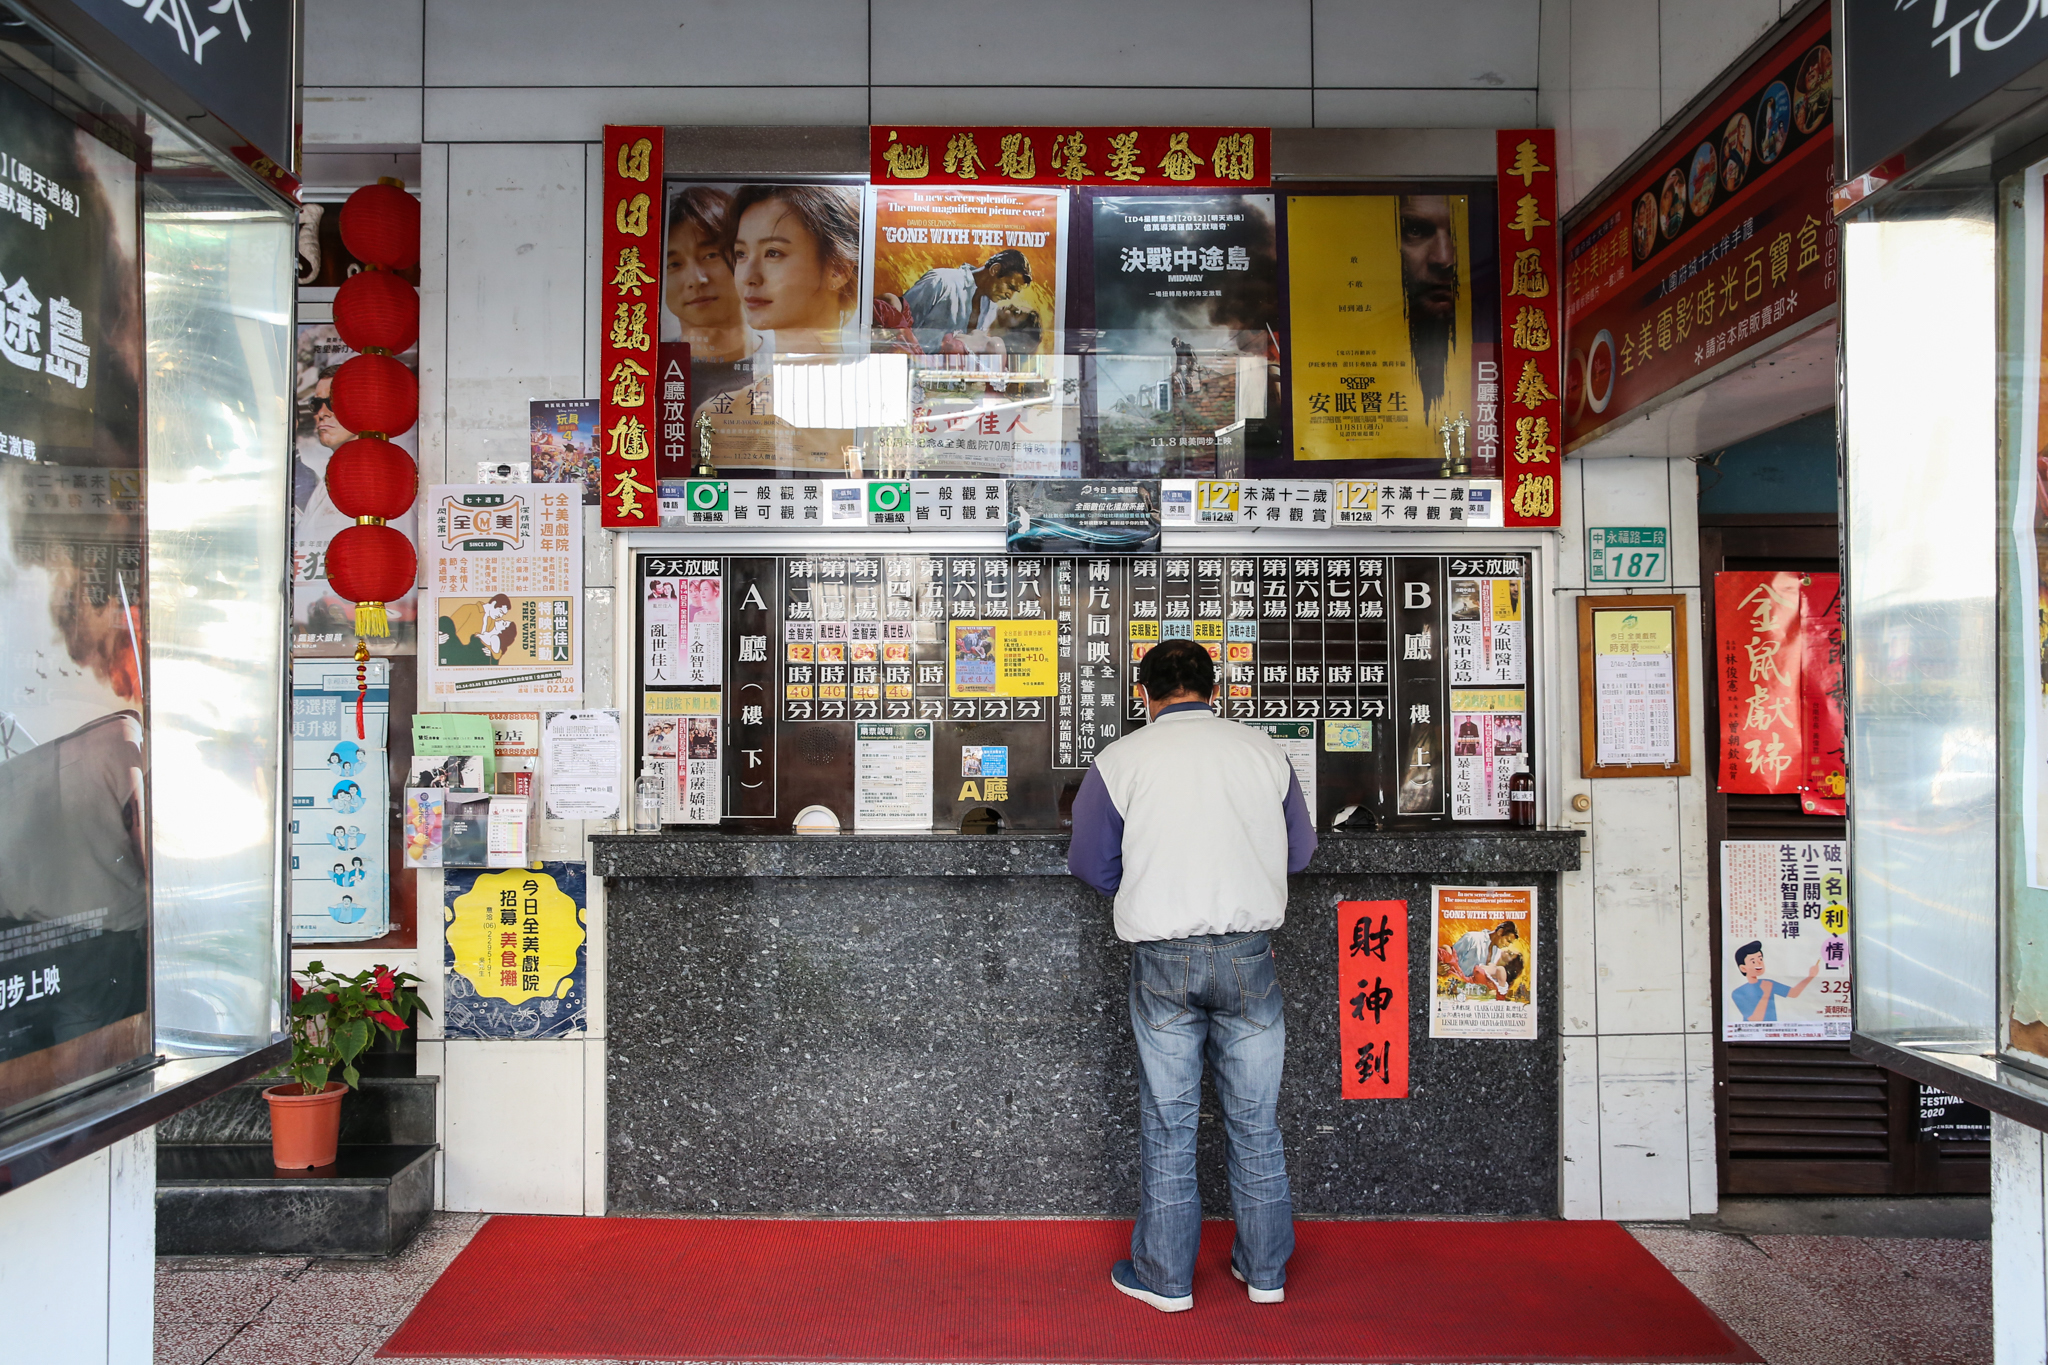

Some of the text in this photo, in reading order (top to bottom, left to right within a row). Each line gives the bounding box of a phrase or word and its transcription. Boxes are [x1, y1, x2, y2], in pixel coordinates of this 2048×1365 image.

[1931, 0, 2048, 78] TO
[913, 192, 922, 202] In
[923, 194, 943, 203] new
[944, 195, 974, 204] screen
[888, 202, 1046, 217] The most magnificent picture ever!
[930, 228, 970, 246] WITH
[972, 229, 1003, 247] THE
[1120, 246, 1250, 272] 決戰中途島
[1659, 217, 1754, 298] 入圍府城十大伴手禮
[1168, 274, 1203, 283] MIDWAY
[1621, 214, 1821, 377] 全美電影時光百寶盒
[1338, 304, 1372, 312] 回到過去
[663, 359, 686, 463] A廳放映中
[1308, 391, 1409, 415] 安眠醫生
[1476, 361, 1500, 464] B廳放映中
[1150, 437, 1232, 447] 11.8 與美同步上映
[733, 485, 818, 501] 一般觀眾
[915, 486, 1000, 501] 一般觀眾
[1093, 486, 1138, 494] 今日 全美戲院
[1244, 486, 1328, 503] 未滿十二歲
[1381, 486, 1464, 501] 未滿十二歲
[733, 505, 818, 520] 皆可觀賞
[915, 505, 1000, 521] 皆可觀賞
[1074, 502, 1145, 511] 全面數位化播放系統
[1169, 505, 1185, 514] 英語
[1243, 505, 1328, 523] 不得觀賞
[1381, 505, 1464, 520] 不得觀賞
[1468, 504, 1484, 512] 英語
[540, 493, 554, 552] 七十週年
[555, 493, 570, 552] 全美戲院
[692, 511, 724, 522] 普遍級
[874, 513, 905, 523] 普遍級
[1201, 511, 1233, 522] 輔12級
[1340, 511, 1373, 522] 輔12級
[1606, 531, 1664, 545] 永福路二段
[1592, 533, 1604, 576] 中西區
[649, 559, 720, 576] 今天放映
[1450, 559, 1520, 575] 今天放映
[1611, 552, 1660, 578] 187
[789, 560, 814, 618] 第一場
[821, 560, 846, 618] 第二場
[854, 560, 879, 618] 第三場
[887, 560, 911, 618] 第四場
[919, 560, 945, 618] 第五場
[951, 560, 977, 618] 第六場
[983, 560, 1009, 618] 第七場
[1017, 560, 1042, 618] 第八場
[1058, 559, 1072, 607] 票既售出
[1132, 559, 1158, 618] 第一場
[1165, 559, 1191, 618] 第二場
[1197, 559, 1222, 618] 第三場
[1229, 559, 1255, 618] 第四場
[1262, 559, 1288, 618] 第五場
[1294, 559, 1320, 618] 第六場
[1326, 559, 1352, 618] 第七場
[1358, 559, 1384, 618] 第八場
[1087, 559, 1111, 664] 兩片同映
[738, 583, 768, 662] A廳
[1131, 624, 1158, 637] 安眠醫生
[1164, 624, 1191, 636] 決戰中途島
[1195, 624, 1222, 637] 安眠醫生
[1402, 582, 1432, 661] B廳
[538, 601, 552, 661] 特映活動
[553, 601, 568, 661] 亂世佳人
[788, 628, 814, 640] 金智英
[820, 624, 848, 639] 亂世佳人
[852, 628, 878, 640] 金智英
[883, 624, 911, 639] 亂世佳人
[1229, 625, 1256, 638] 決戰中途島
[1627, 632, 1657, 640] 全美戲院
[651, 623, 668, 681] 亂世佳人
[791, 647, 810, 659] 12
[820, 647, 841, 659] 02
[1229, 646, 1250, 658] 09
[1453, 623, 1472, 682] 決戰中途島
[1494, 623, 1512, 681] 安眠醫生
[1609, 643, 1640, 653] 時刻表
[689, 640, 704, 682] 金智英
[788, 666, 813, 683] 時
[820, 666, 845, 683] 時
[853, 666, 877, 683] 時
[886, 666, 911, 683] 時
[1231, 666, 1255, 683] 時
[547, 685, 574, 693] 02.14
[789, 687, 810, 698] 40
[823, 686, 841, 697] 40
[857, 687, 875, 698] 40
[889, 686, 909, 698] 40
[1230, 686, 1249, 697] 20
[1736, 583, 1797, 786] 金鼠獻瑞
[1058, 672, 1072, 717] 現金戲票
[787, 700, 813, 718] 分
[820, 700, 846, 718] 分
[853, 700, 878, 718] 分
[886, 700, 912, 718] 分
[1231, 700, 1256, 718] 分
[1058, 719, 1072, 765] 當面點清
[957, 777, 1009, 802] A廳
[1801, 844, 1821, 920] 小三關的
[1780, 844, 1800, 939] 生活智慧禪
[1467, 910, 1487, 919] WITH
[1488, 910, 1505, 919] THE
[500, 889, 517, 987] 招募 美食攤
[522, 879, 540, 992] 今日全美戲院
[1349, 914, 1395, 1085] 財神到
[1920, 1095, 1965, 1107] FESTIVAL
[1920, 1108, 1945, 1118] 2020
